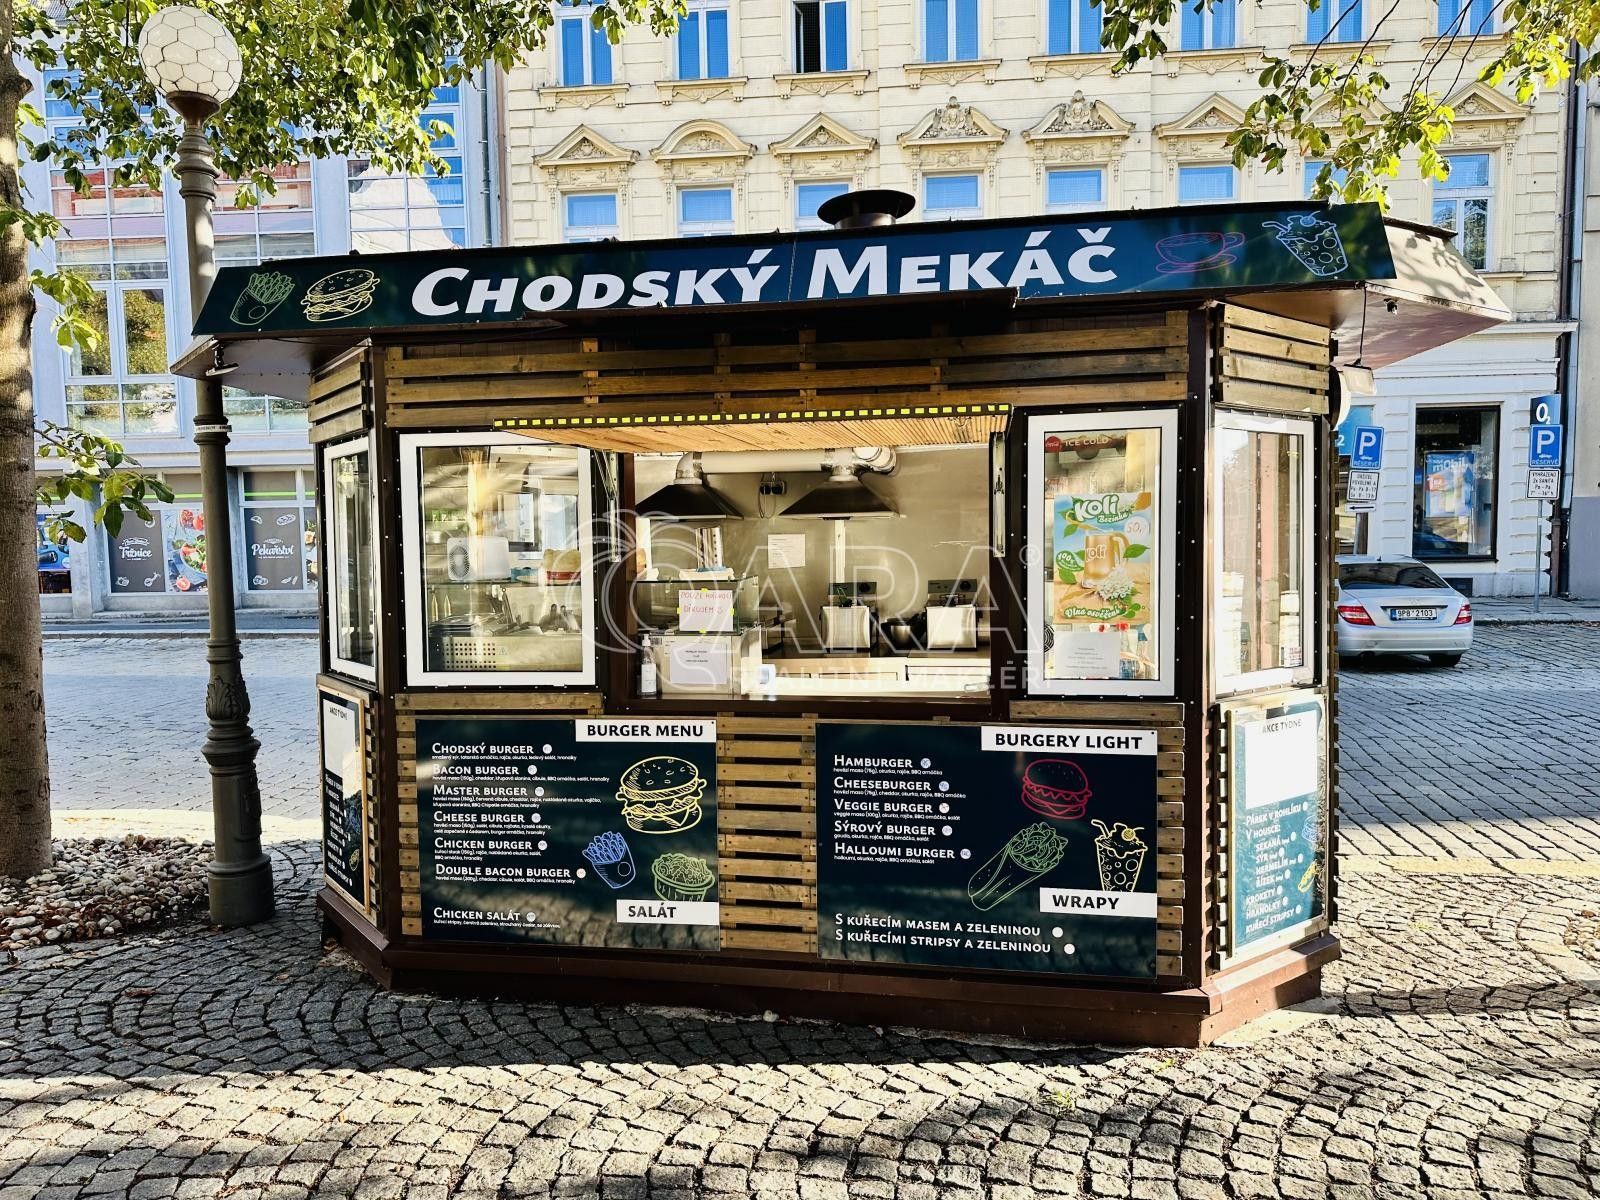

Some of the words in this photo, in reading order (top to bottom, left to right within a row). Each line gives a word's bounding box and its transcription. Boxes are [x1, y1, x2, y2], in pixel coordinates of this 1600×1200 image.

[412, 249, 780, 316] CHODSKÝ
[806, 228, 1116, 298] MEKÁČ
[1359, 432, 1376, 455] P
[1536, 430, 1554, 453] P
[587, 724, 650, 736] BURGER
[656, 725, 704, 737] MENU
[432, 742, 486, 754] CHODSKÝ
[490, 745, 534, 754] BURGER
[995, 733, 1080, 748] BURGERY
[1086, 735, 1143, 750] LIGHT
[834, 755, 912, 768] HAMBURGER
[433, 764, 471, 774] BACON
[476, 766, 520, 775] BURGER
[434, 785, 481, 796] MASTER
[484, 788, 528, 797] BURGER
[834, 776, 932, 791] CHEESEBURGER
[834, 799, 880, 812] VEGGIE
[884, 802, 932, 812] BURGER
[434, 811, 478, 822] CHEESE
[482, 814, 524, 823] BURGER
[834, 820, 882, 834] SÝROVÝ
[886, 824, 936, 836] BURGER
[435, 837, 486, 850] CHICKEN
[488, 840, 532, 850] BURGER
[834, 842, 902, 857] HALLOUMI
[906, 846, 956, 860] BURGER
[436, 864, 482, 876] DOUBLE
[485, 867, 522, 877] BACON
[526, 868, 571, 878] BURGER
[1052, 894, 1120, 910] WRAPY
[434, 908, 484, 920] CHICKEN
[486, 910, 521, 921] SALÁT
[628, 902, 676, 919] SALÁT
[836, 913, 842, 925] S
[847, 914, 902, 928] KUŘECÍM
[906, 920, 950, 932] MASEM
[954, 923, 963, 932] A
[966, 923, 1041, 936] ZELENINOU
[836, 929, 842, 941] S
[847, 930, 906, 945] KUŘECÍMI
[910, 936, 960, 948] STRIPSY
[964, 939, 974, 949] A
[977, 940, 1051, 954] ZELENINOU
